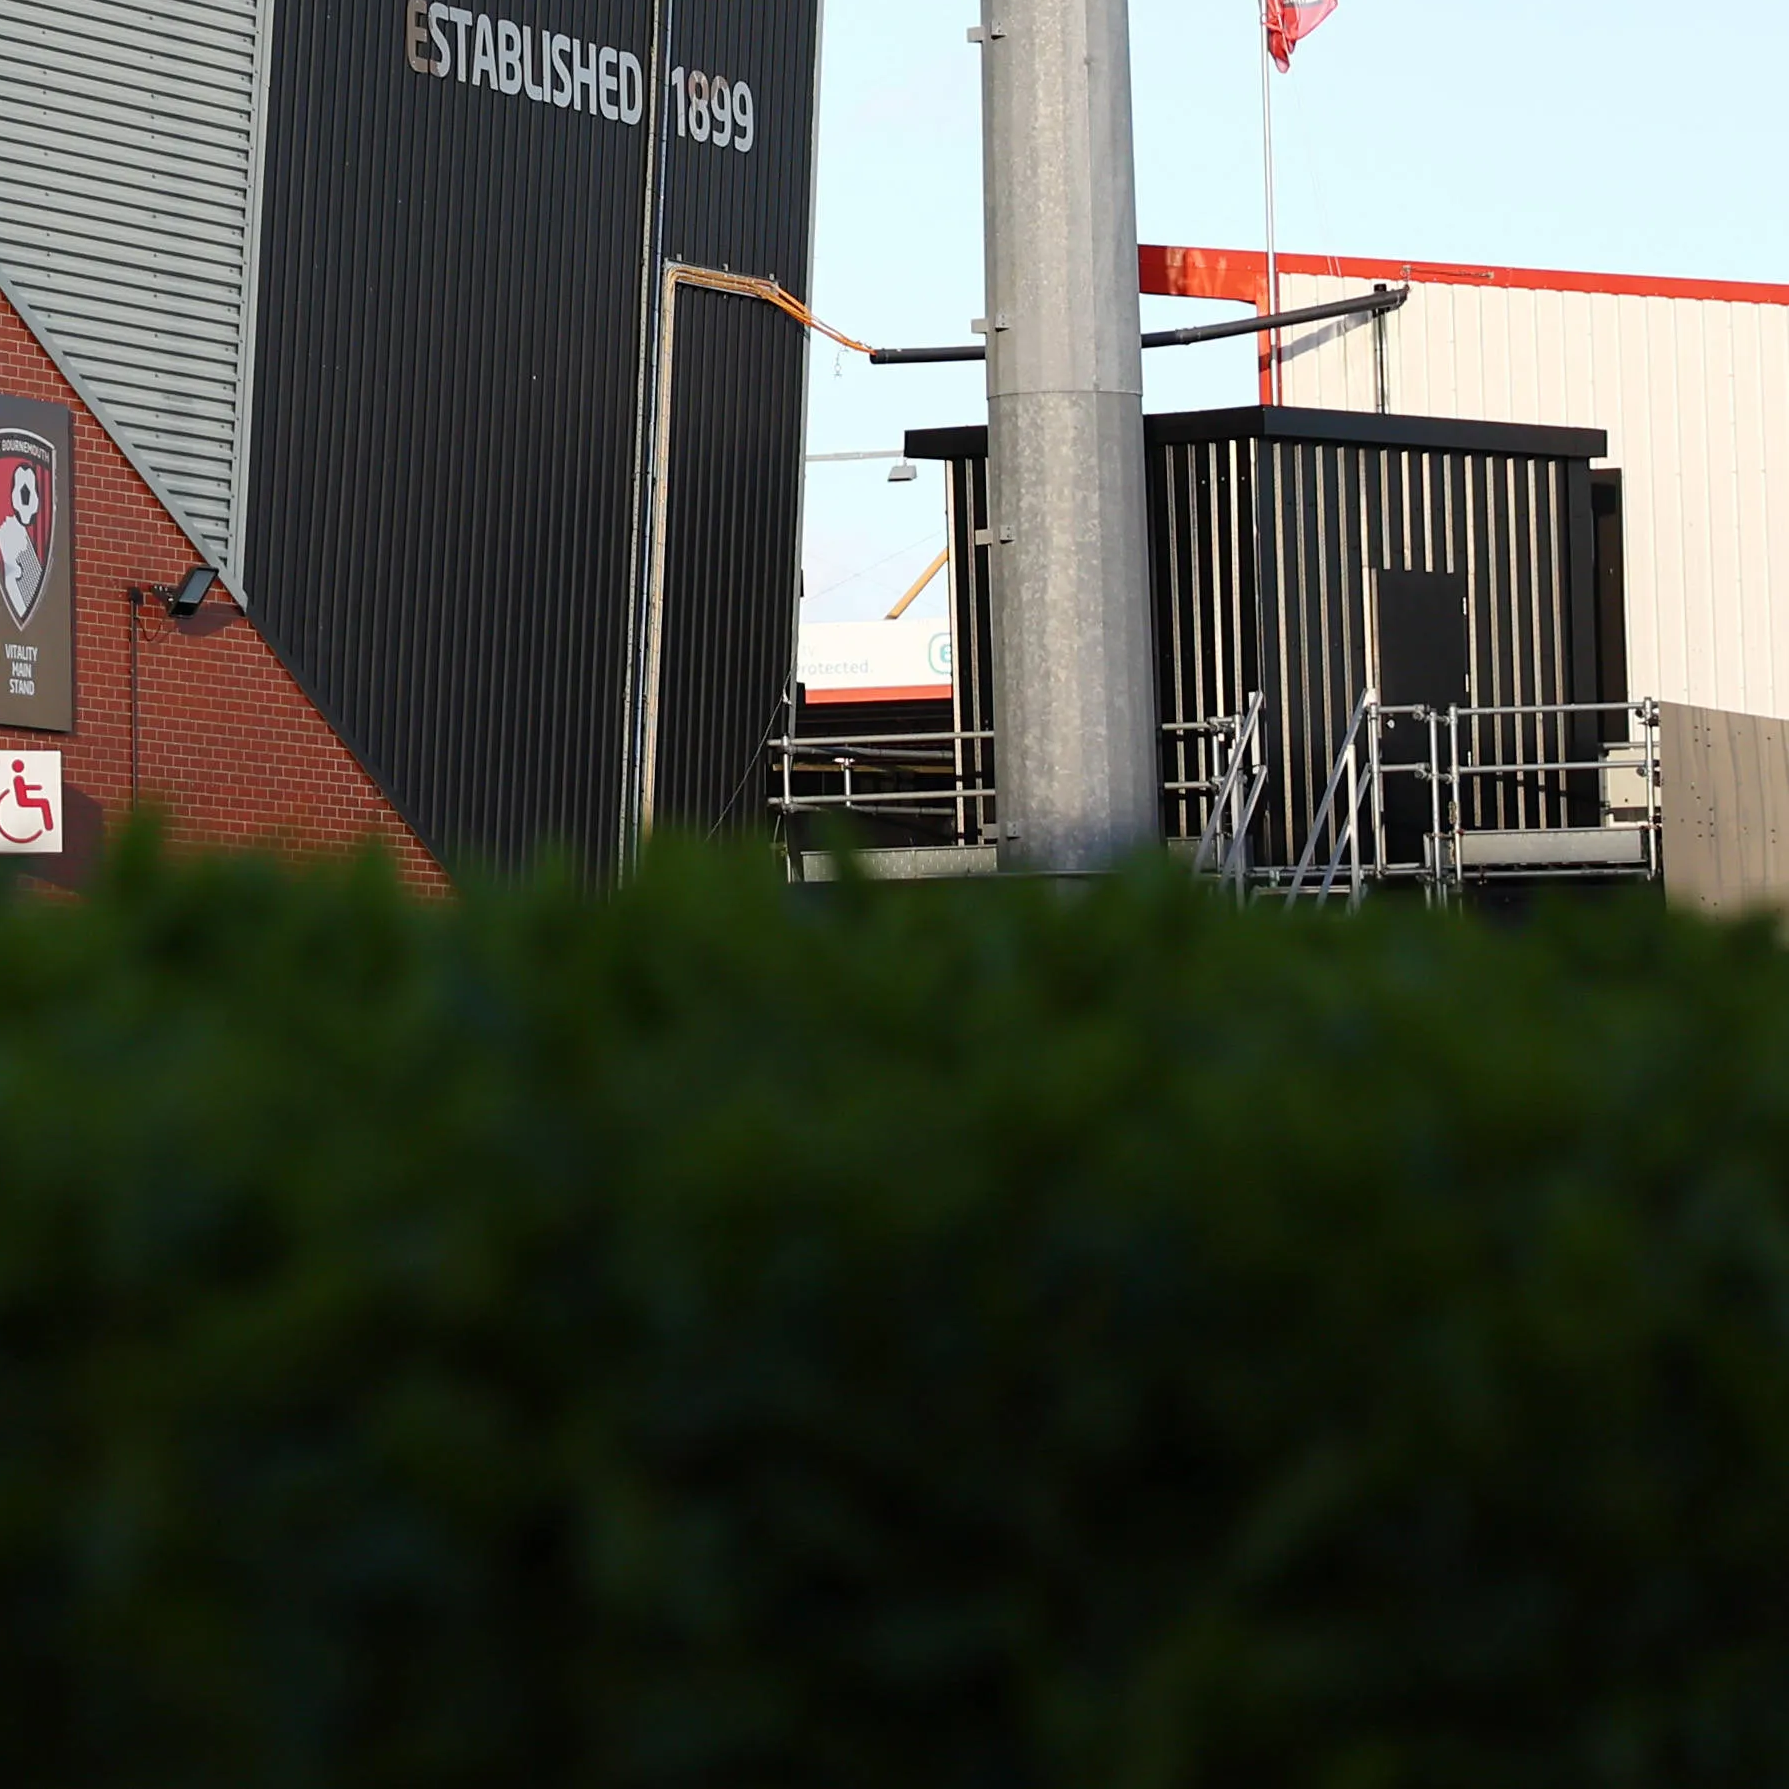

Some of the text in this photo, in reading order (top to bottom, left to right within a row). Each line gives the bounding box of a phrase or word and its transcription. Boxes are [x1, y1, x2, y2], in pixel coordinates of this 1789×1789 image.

[671, 65, 754, 153] 1899
[4, 643, 38, 662] VITALITY
[11, 661, 32, 678] MAIN
[798, 659, 873, 676] rotected.
[9, 678, 35, 696] STAND
